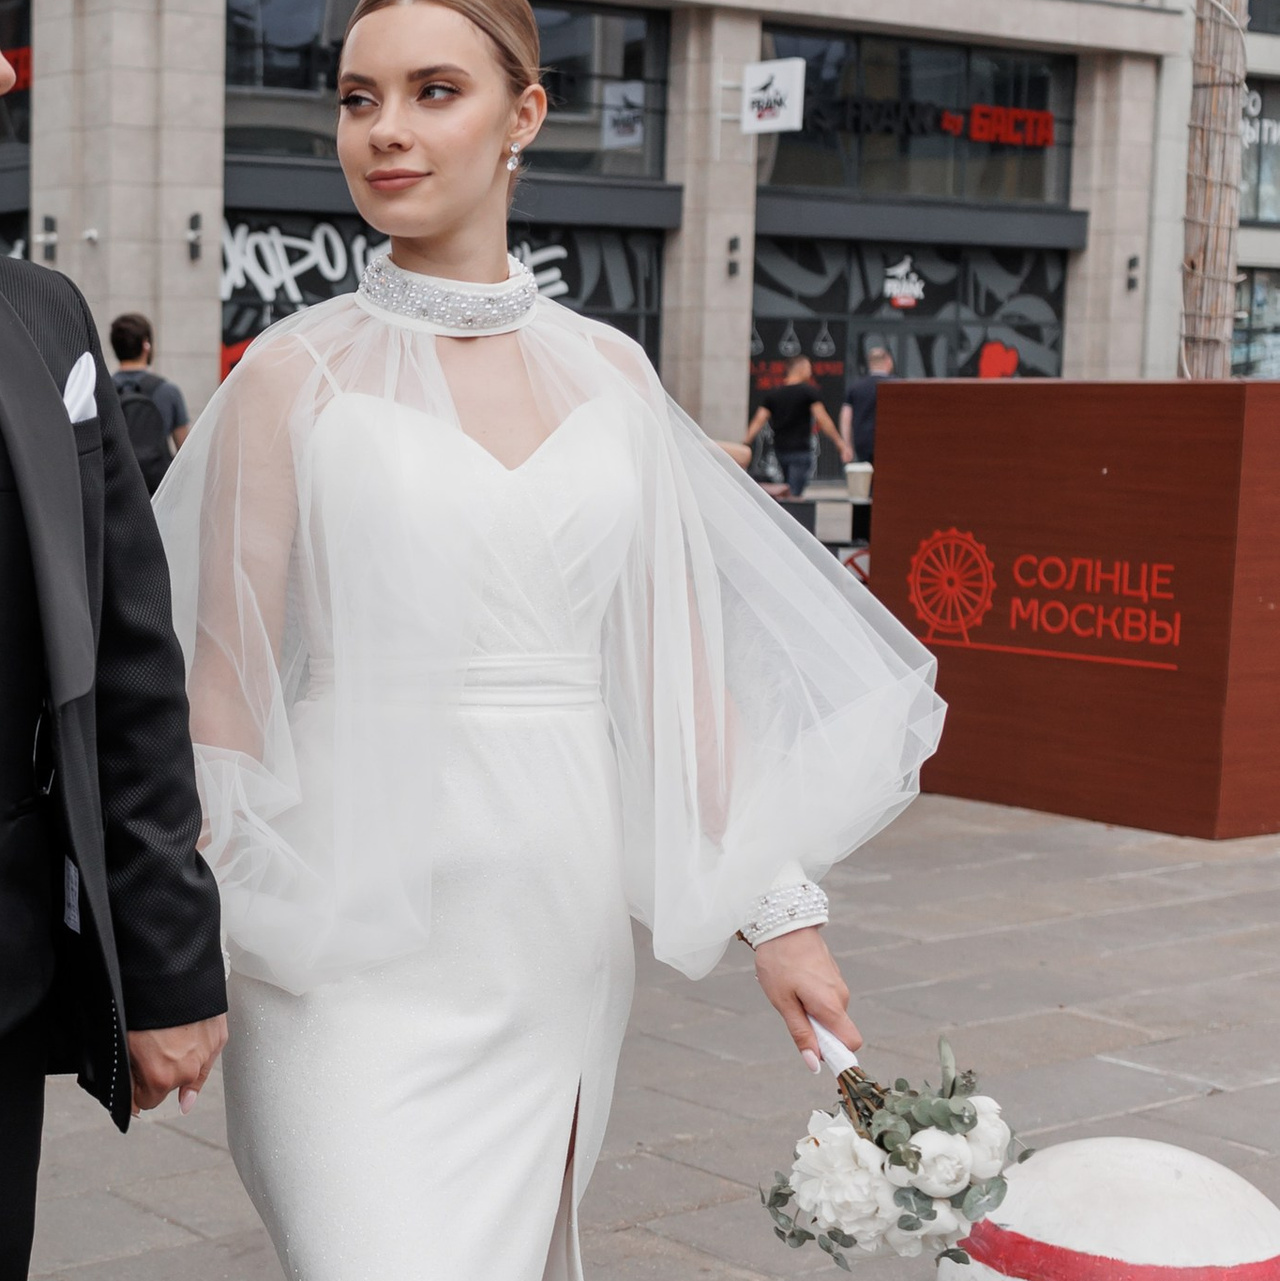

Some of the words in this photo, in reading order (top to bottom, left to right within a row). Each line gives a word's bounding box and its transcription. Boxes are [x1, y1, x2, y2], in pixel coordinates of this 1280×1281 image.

[970, 103, 1054, 147] БАСТА
[1013, 554, 1175, 603] СОЛНЦЕ
[1010, 597, 1181, 647] МОСКВЫ
